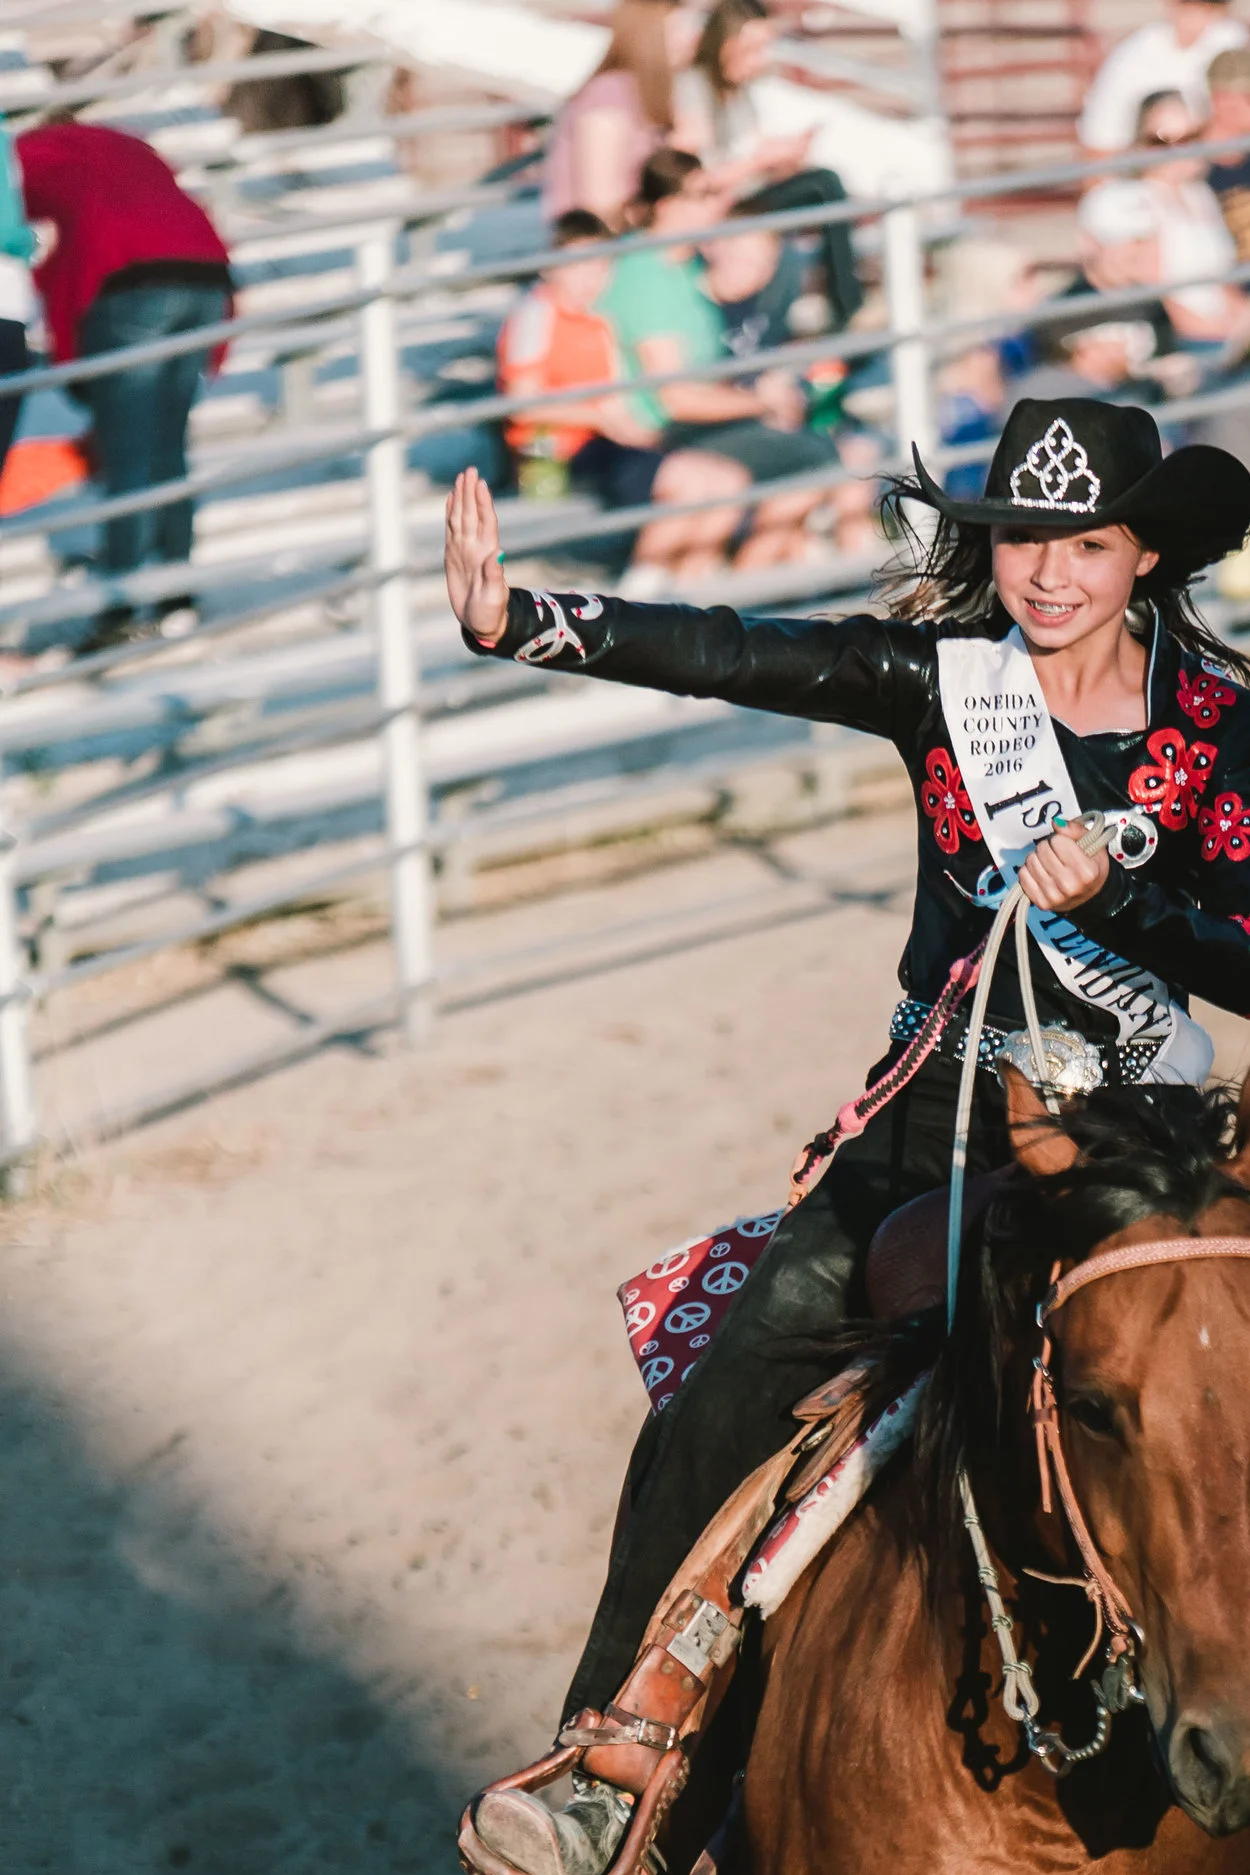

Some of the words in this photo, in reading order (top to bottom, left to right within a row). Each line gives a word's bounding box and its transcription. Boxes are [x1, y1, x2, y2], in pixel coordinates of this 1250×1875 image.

[964, 694, 1037, 711] ONEIDA
[963, 713, 1043, 733] COUNTY
[970, 735, 1036, 756] RODEO
[984, 758, 1023, 777] 2016
[984, 780, 1063, 843] 1S
